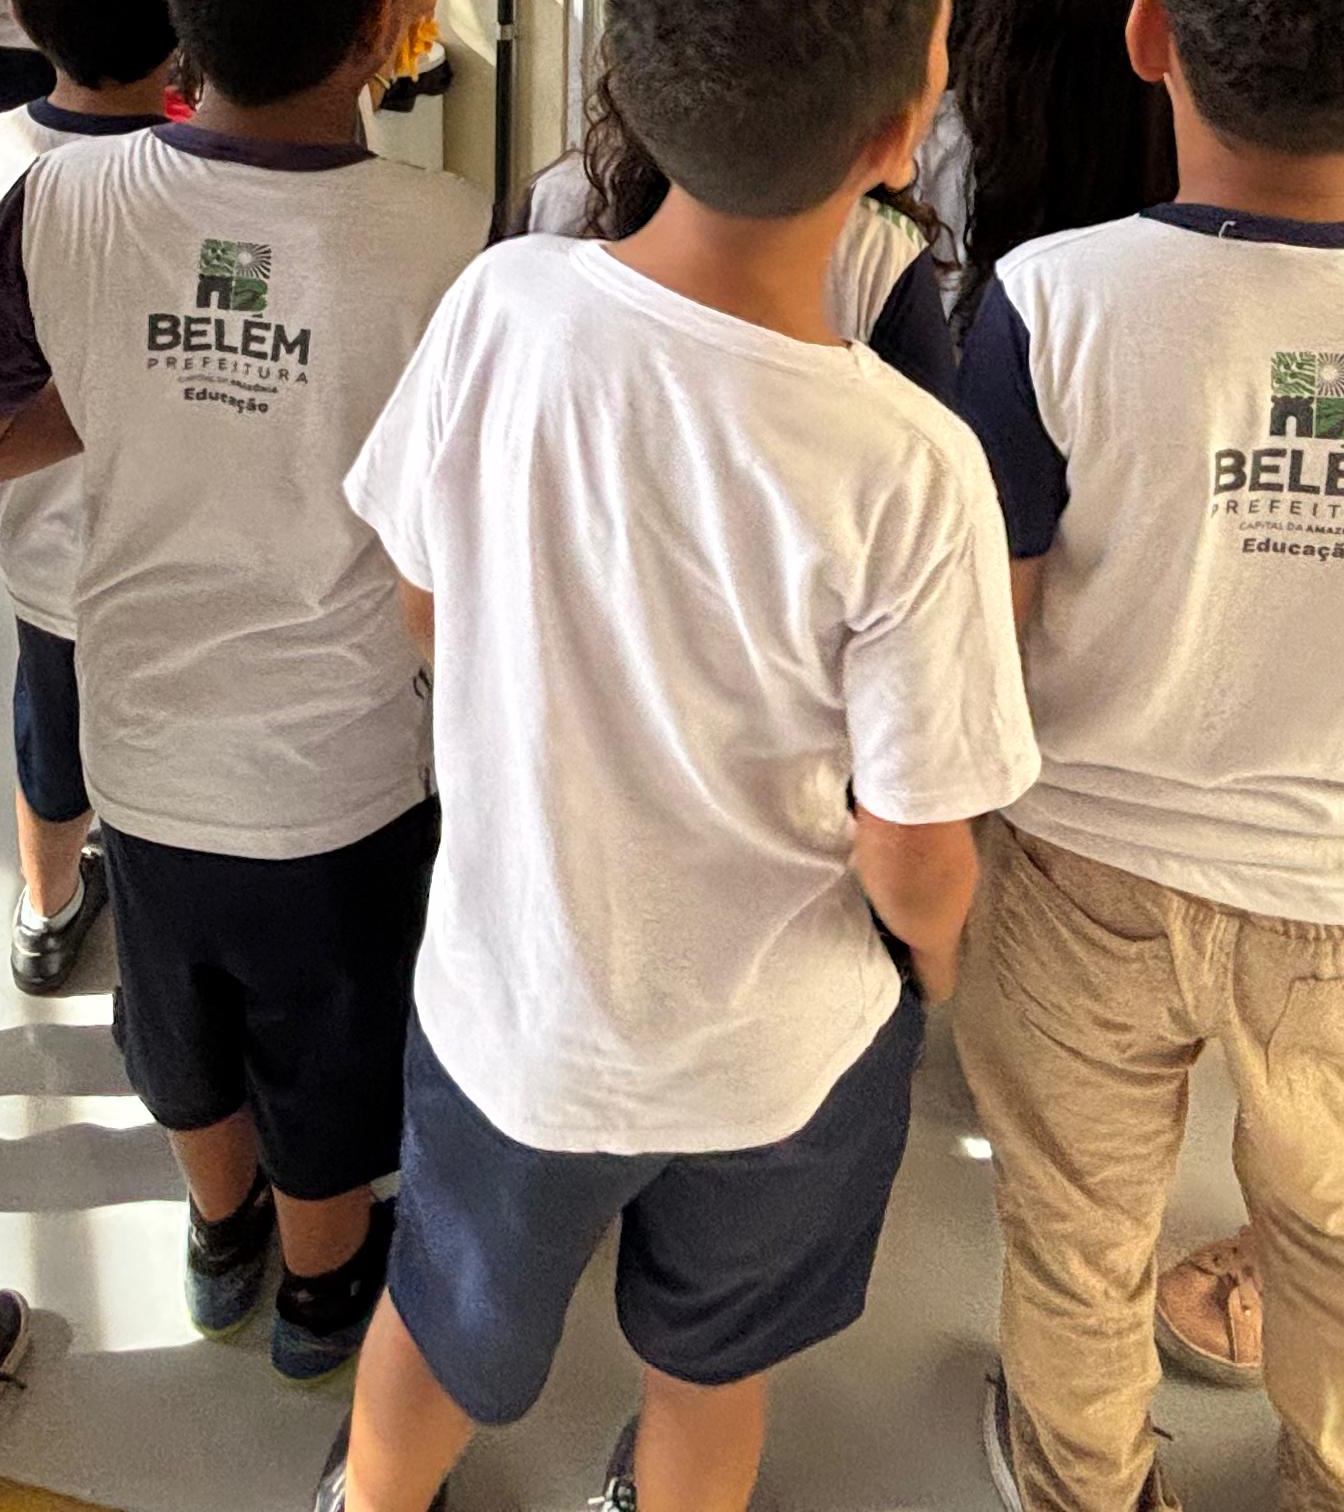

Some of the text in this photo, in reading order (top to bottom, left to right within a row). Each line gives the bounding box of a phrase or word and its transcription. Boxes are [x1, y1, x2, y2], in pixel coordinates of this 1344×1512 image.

[147, 312, 311, 366] BELÉM
[147, 356, 309, 385] PREFEITURA
[184, 387, 269, 414] Educação
